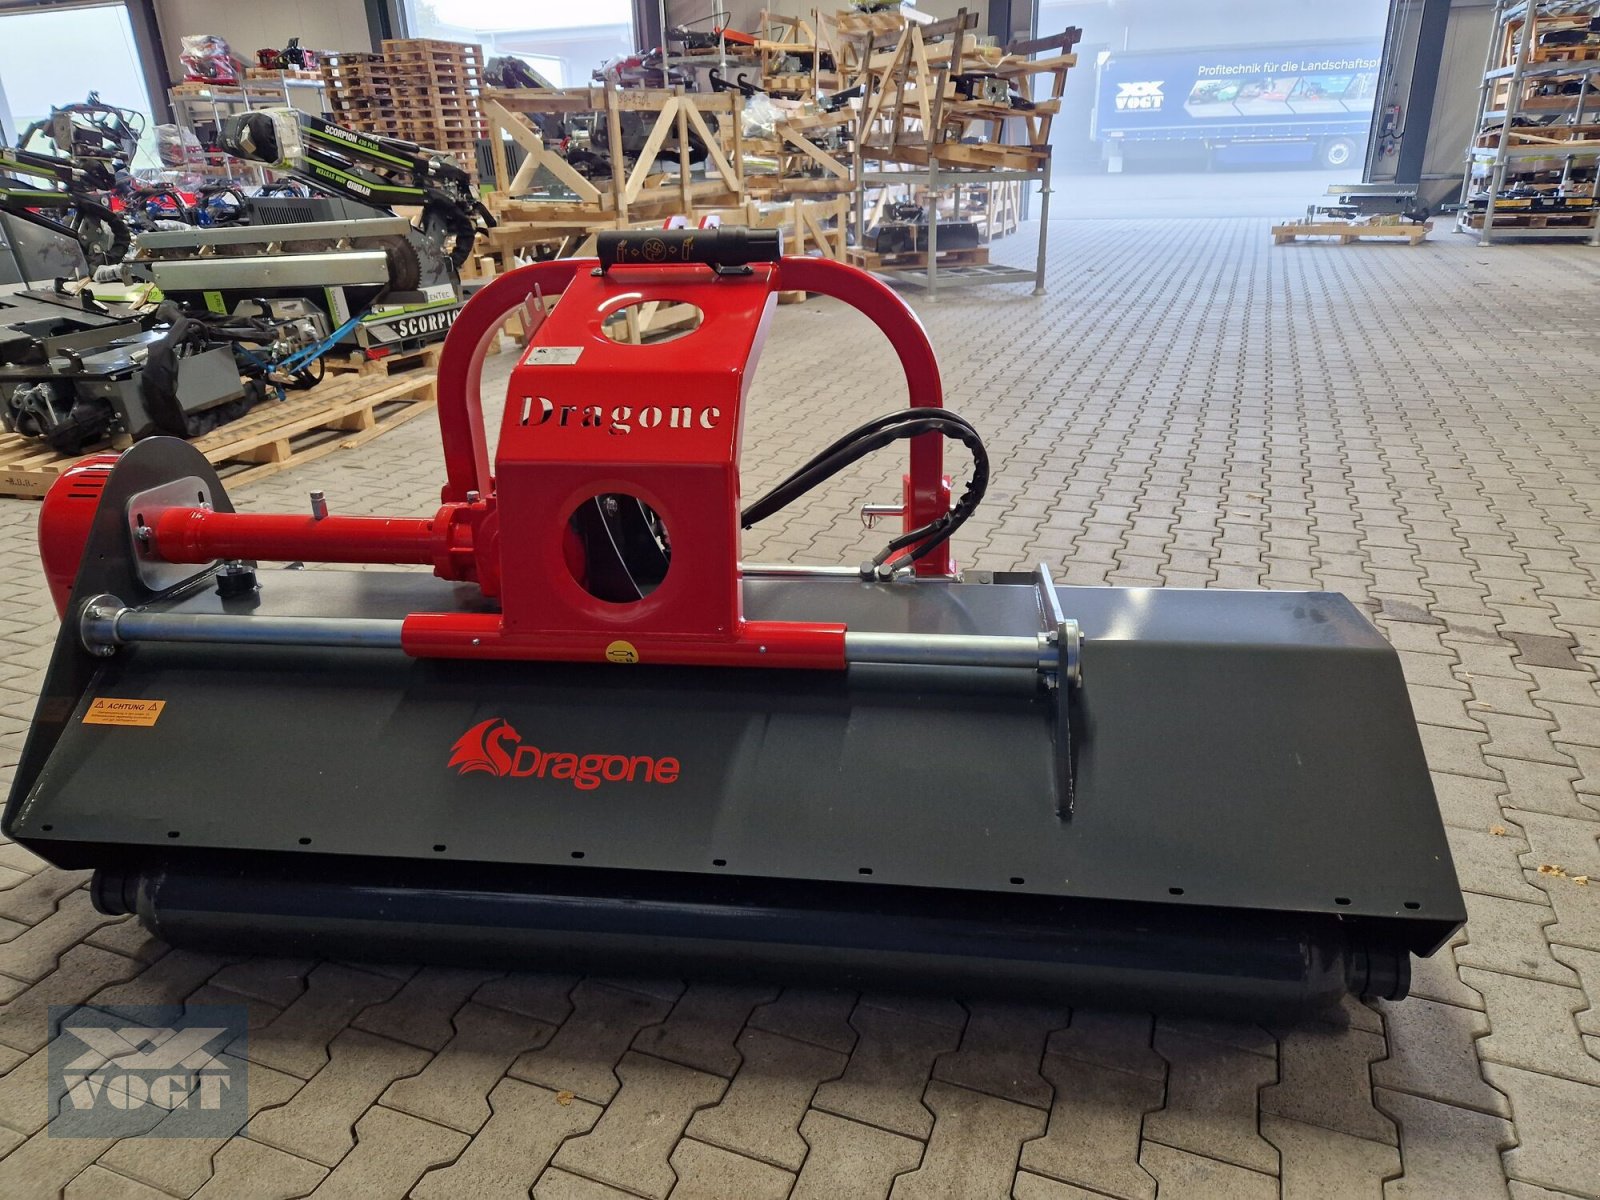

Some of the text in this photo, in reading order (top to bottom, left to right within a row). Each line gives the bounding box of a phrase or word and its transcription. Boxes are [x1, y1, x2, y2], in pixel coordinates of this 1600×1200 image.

[1198, 63, 1260, 76] Profitechnik
[1263, 61, 1279, 73] für
[1281, 61, 1298, 72] die
[1115, 96, 1165, 110] VOGT
[325, 124, 358, 144] SCORPION
[346, 180, 371, 196] HYBRID
[428, 291, 450, 300] ENTEC
[399, 309, 460, 337] SCORPIO
[516, 395, 721, 435] Dragone
[107, 703, 145, 711] ACHTUNG
[510, 746, 680, 790] Dragone
